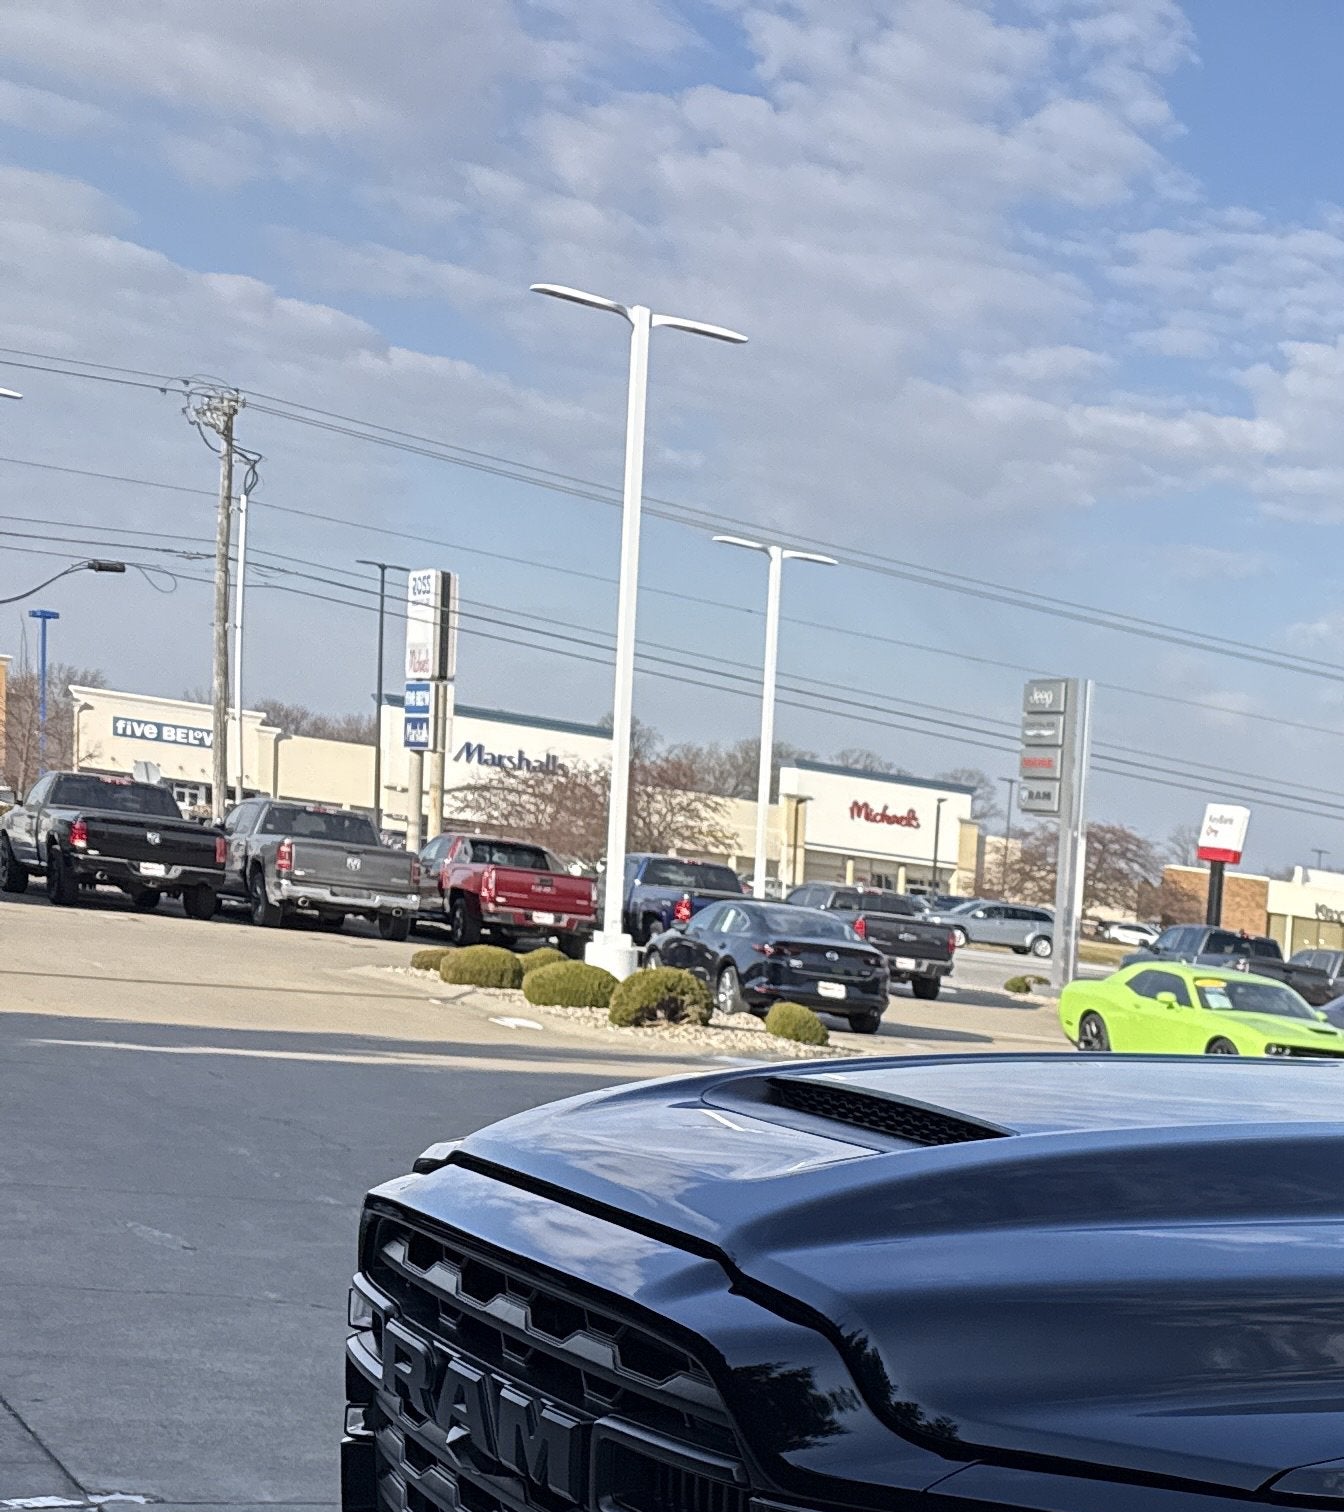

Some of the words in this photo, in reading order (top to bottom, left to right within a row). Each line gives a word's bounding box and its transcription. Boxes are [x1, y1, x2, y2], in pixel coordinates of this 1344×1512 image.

[1029, 687, 1053, 708] Jeep
[1027, 790, 1052, 801] RAM
[849, 799, 921, 829] Michaels
[383, 1317, 592, 1505] RAM
